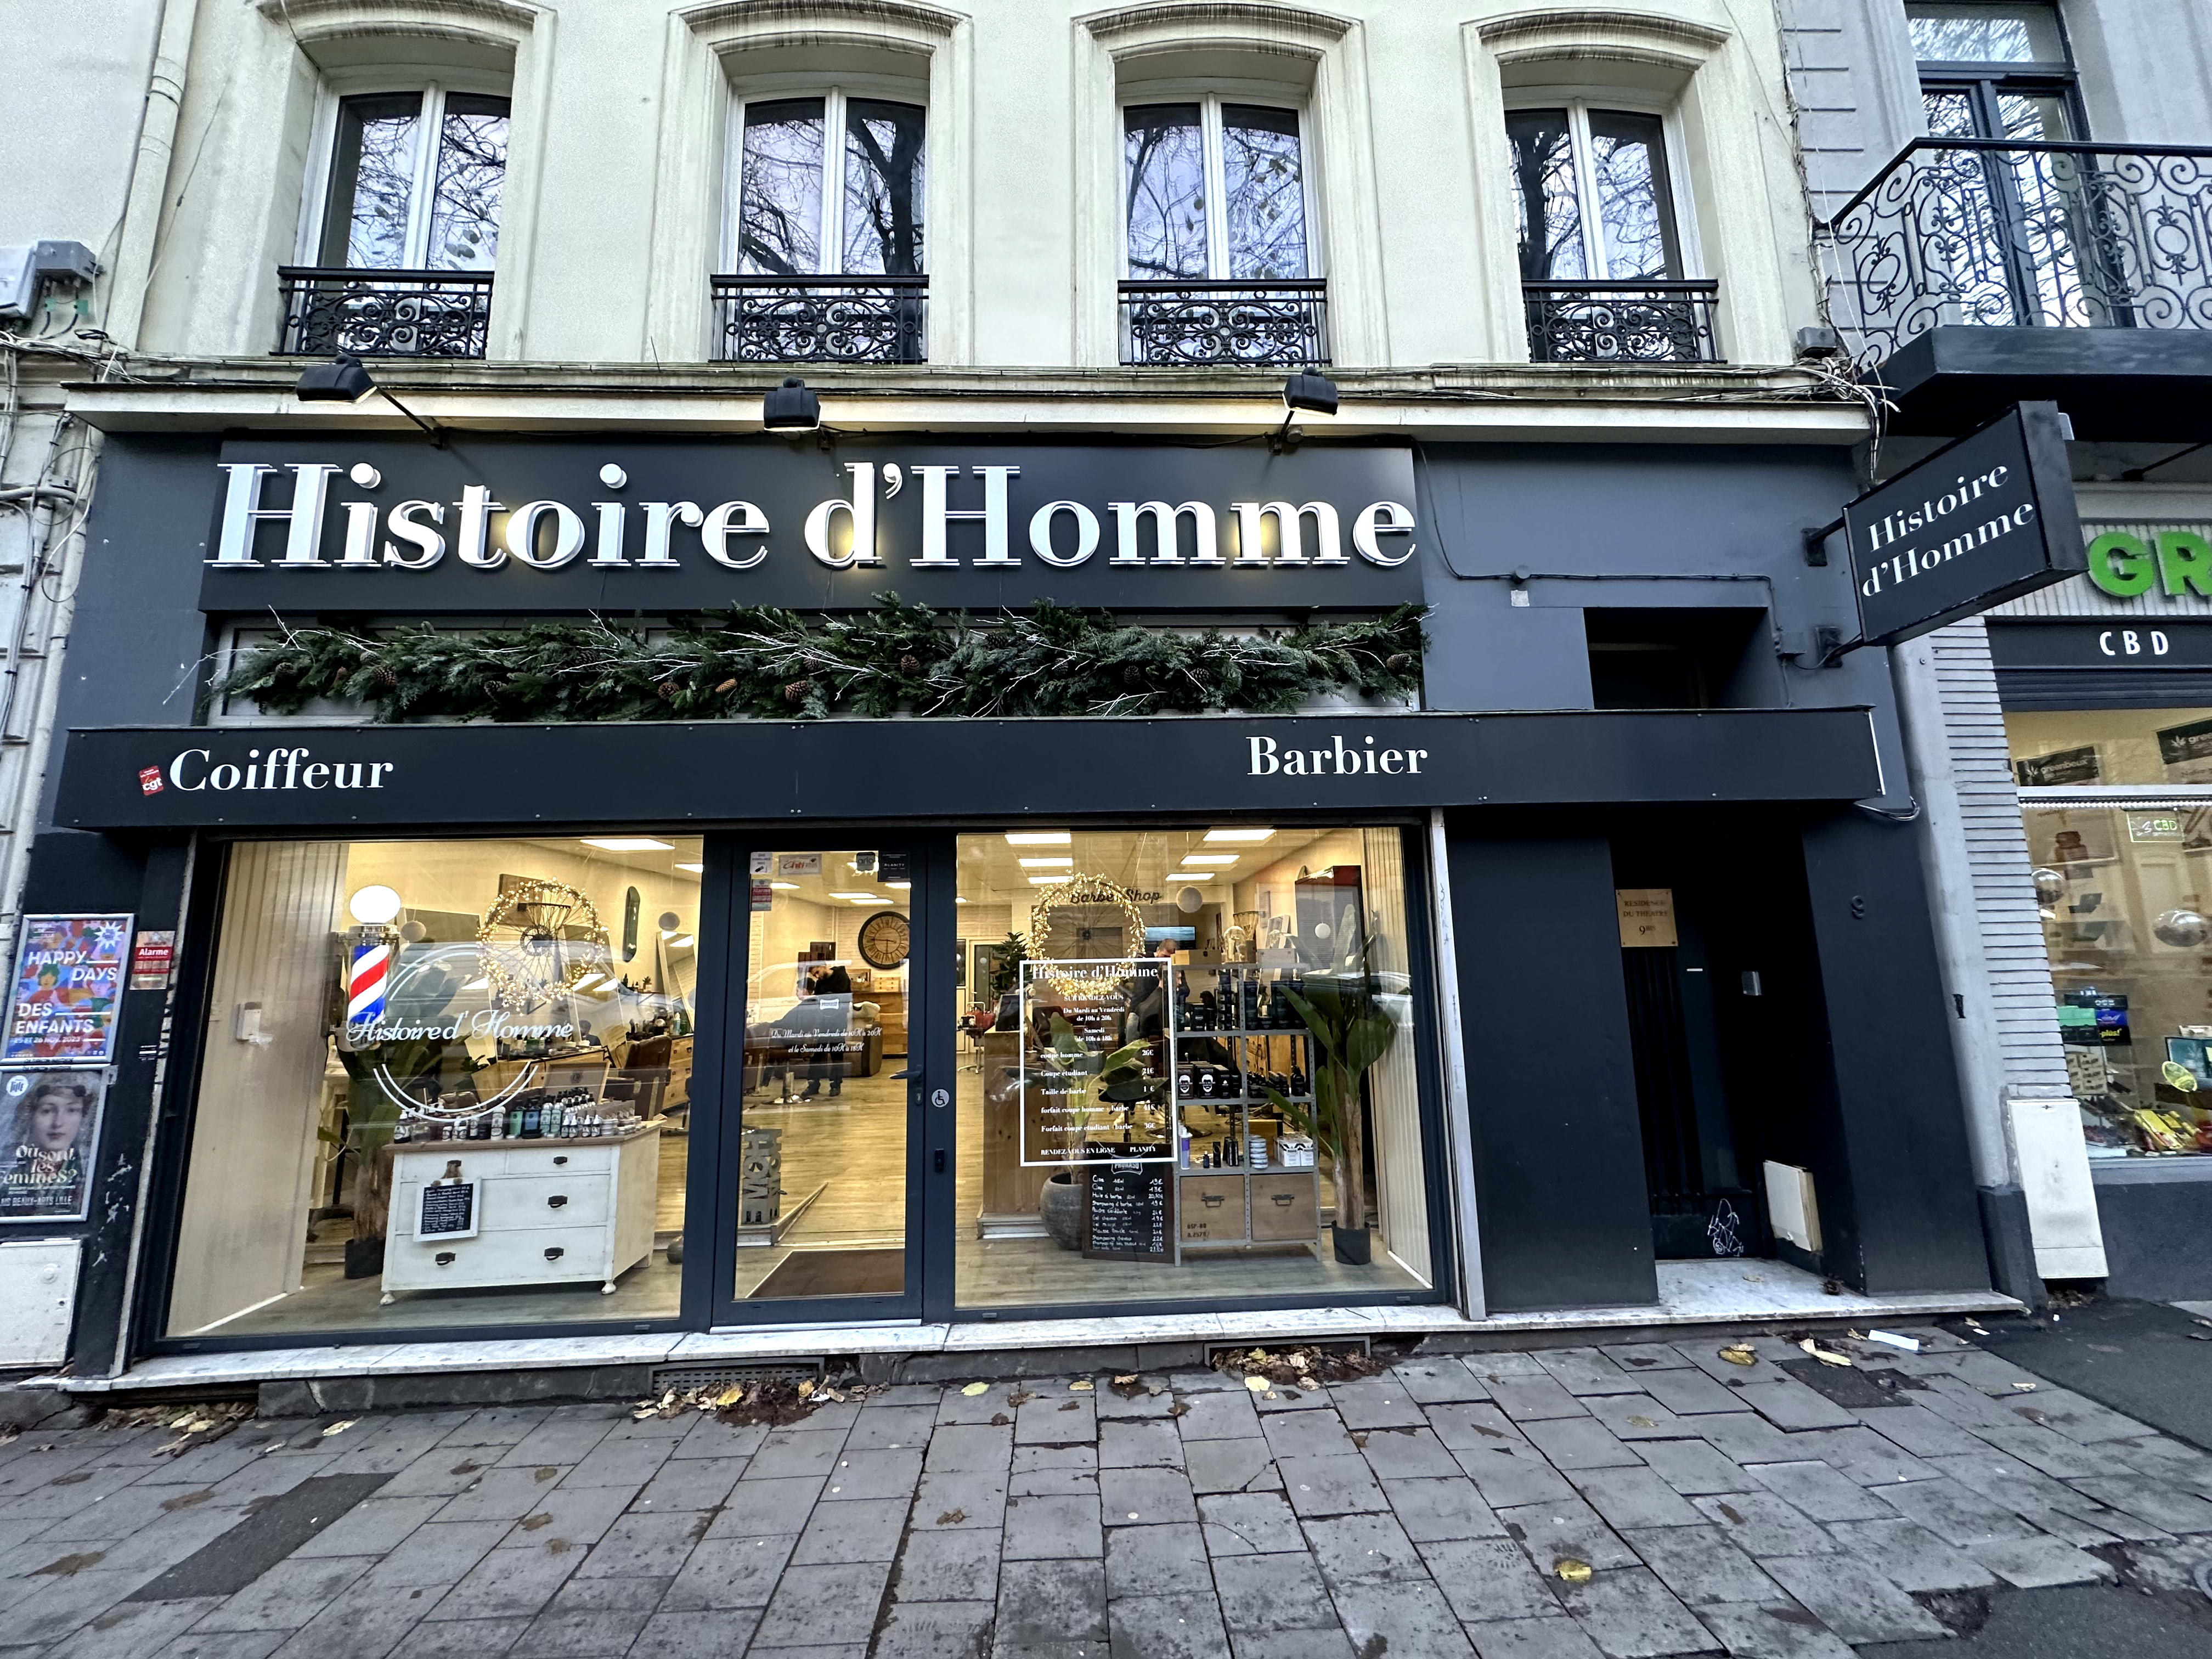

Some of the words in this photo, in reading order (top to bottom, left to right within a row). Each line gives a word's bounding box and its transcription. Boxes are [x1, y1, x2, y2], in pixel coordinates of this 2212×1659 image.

[204, 463, 770, 569] Histoire
[804, 462, 1417, 568] d'Homme
[1867, 465, 2008, 552] Histoire
[1863, 503, 2035, 597] d'Homme
[2099, 630, 2169, 656] CBD
[1245, 735, 1428, 775] Barbier
[170, 748, 394, 791] Coiffeur
[142, 777, 163, 791] cgt
[2154, 819, 2177, 831] CBD
[857, 855, 874, 864] arlo
[1070, 890, 1120, 904] Barbe
[1125, 888, 1162, 905] Shop
[1852, 895, 1865, 919] 9
[28, 951, 87, 964] HAPPY
[71, 967, 118, 981] DAYS
[1032, 966, 1087, 979] Histoire
[1091, 965, 1158, 978] d'Homme
[19, 1002, 53, 1017] DES
[15, 1019, 94, 1034] ENFANTS
[345, 1011, 441, 1042] Histoire
[782, 1029, 804, 1038] Mardi
[812, 1028, 840, 1037] Vendredi
[840, 1028, 847, 1037] de
[867, 1026, 883, 1036] 20H
[794, 1044, 799, 1053] le
[800, 1043, 823, 1053] Samedi
[823, 1043, 831, 1052] de
[832, 1042, 845, 1052] 10H
[38, 1148, 76, 1162] sont
[31, 1159, 55, 1173] les
[12, 1197, 54, 1206] BEAUX-ARTS
[55, 1195, 73, 1205] LILLE
